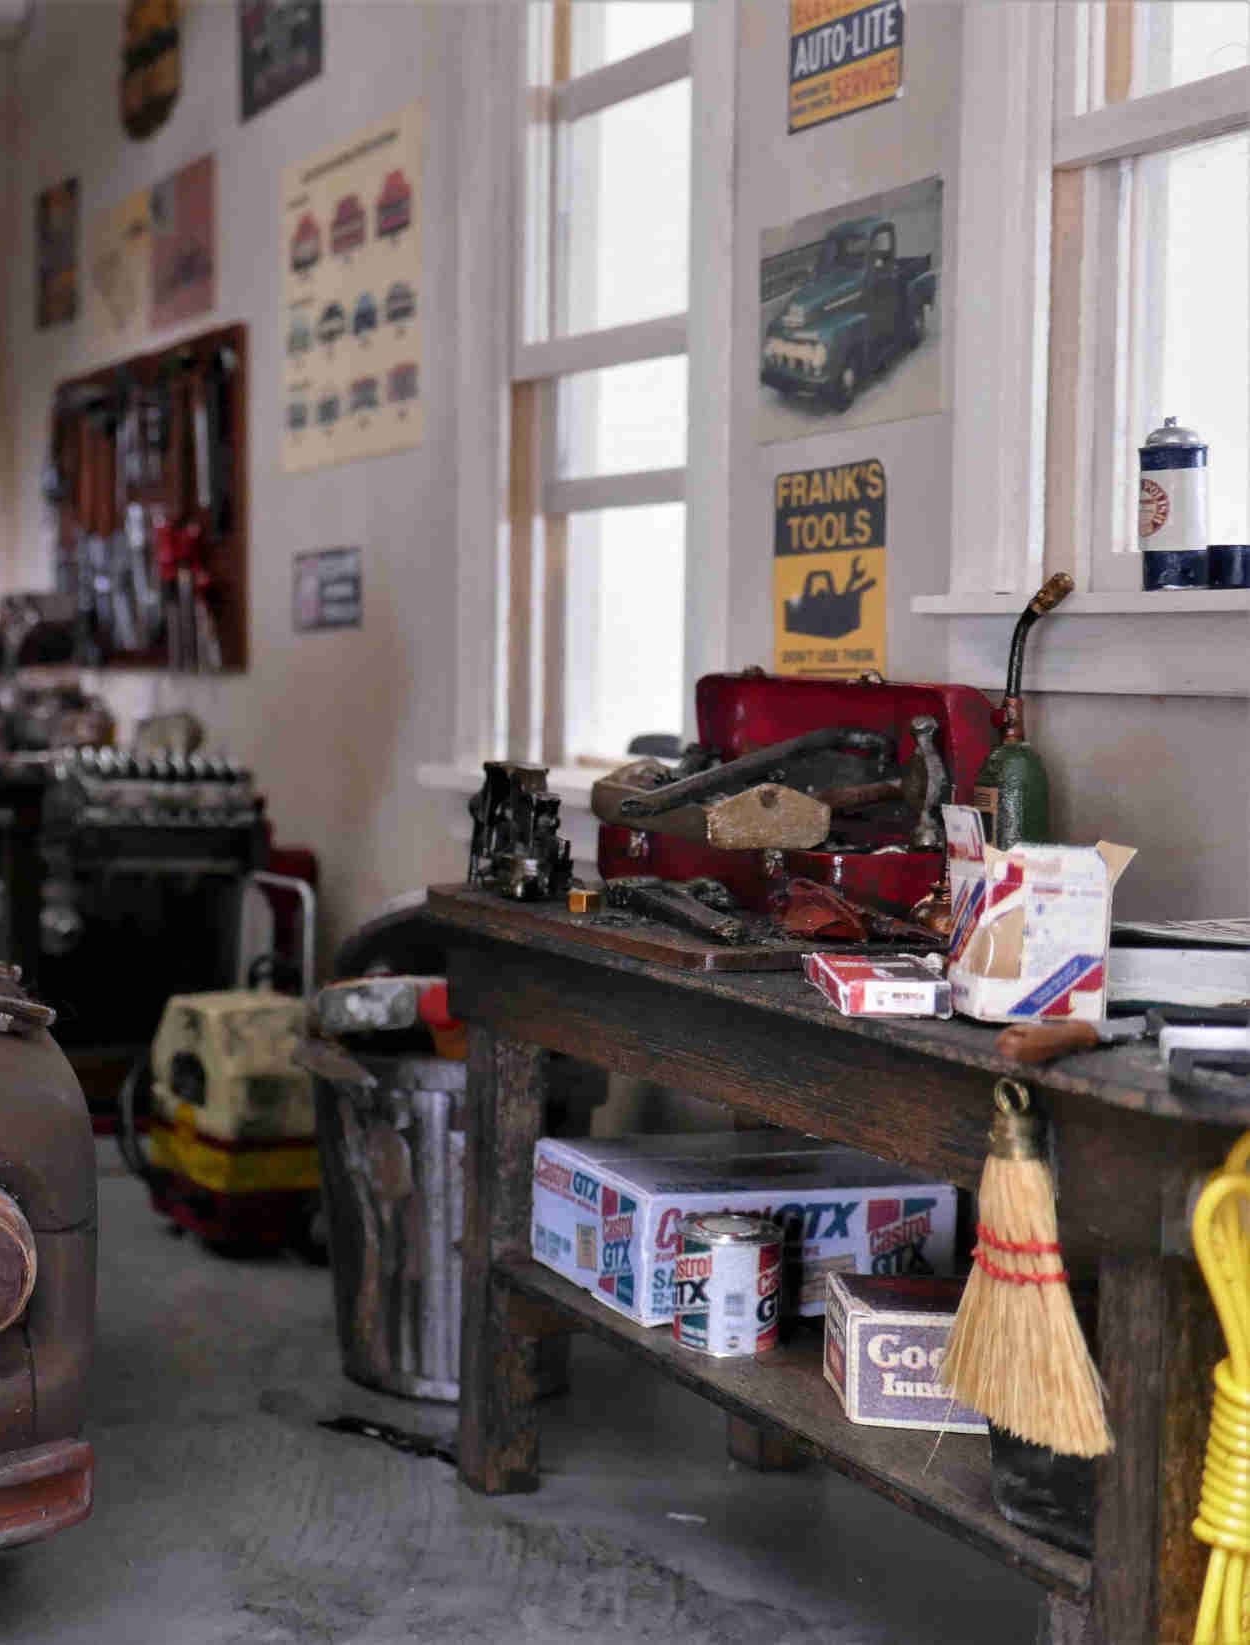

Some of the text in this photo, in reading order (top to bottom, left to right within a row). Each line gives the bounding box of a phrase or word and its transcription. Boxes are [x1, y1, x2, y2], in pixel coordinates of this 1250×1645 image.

[794, 2, 898, 79] AUTO-LITE
[833, 54, 897, 105] SERVICE
[775, 463, 883, 509] FRANK'S
[786, 509, 872, 550] TOOLS
[573, 1171, 600, 1204] GTX
[602, 1214, 633, 1243] Castrol
[870, 1209, 931, 1256] Castrol
[602, 1239, 631, 1269] GTX
[676, 1255, 712, 1280] strol
[676, 1278, 710, 1304] TX
